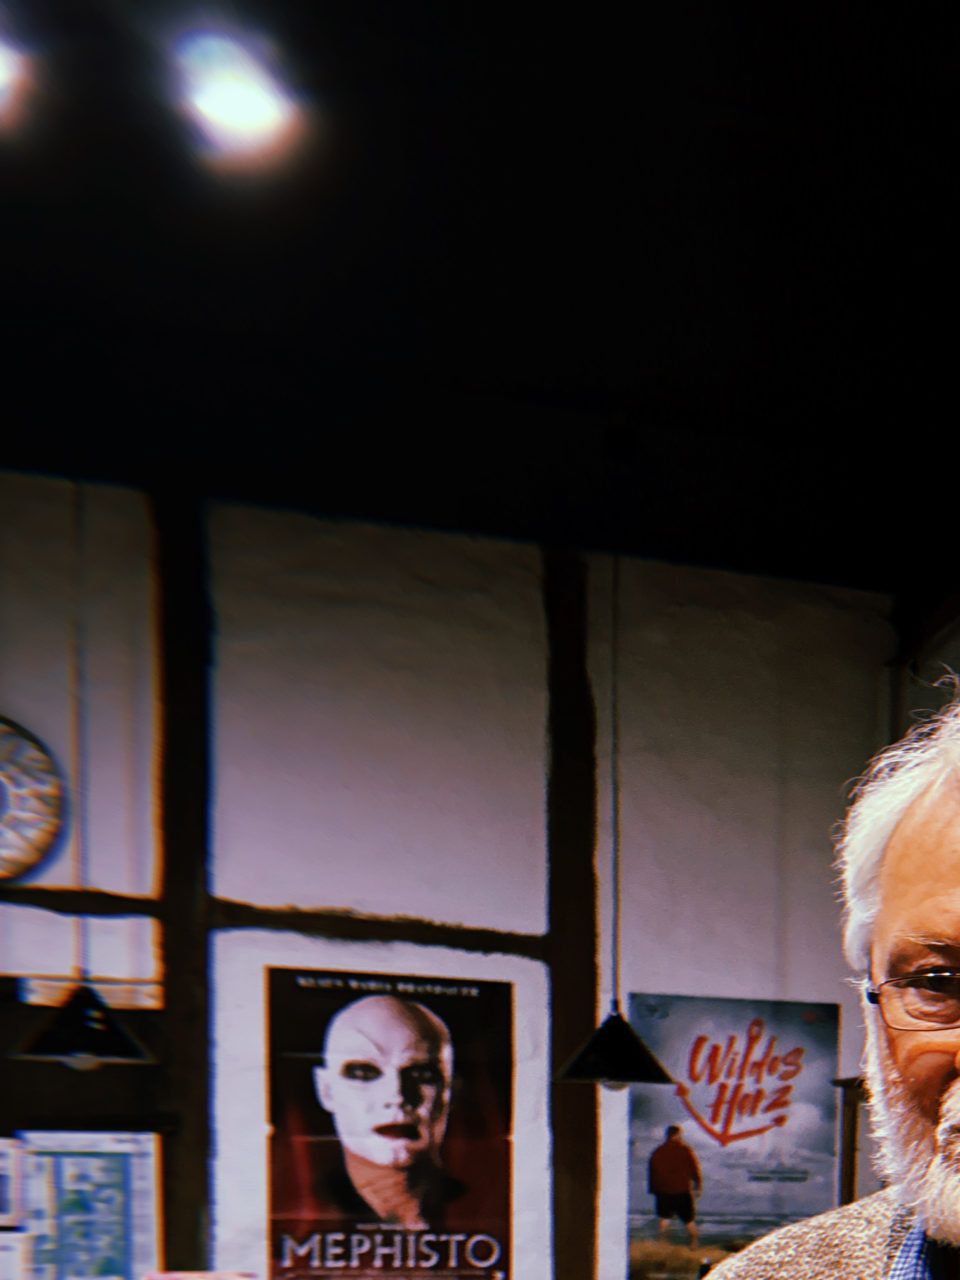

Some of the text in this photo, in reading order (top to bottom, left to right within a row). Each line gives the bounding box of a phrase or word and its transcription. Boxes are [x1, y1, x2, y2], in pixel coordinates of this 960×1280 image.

[689, 1018, 806, 1085] Wildes
[707, 1082, 794, 1131] Herz
[279, 1232, 502, 1268] MEPHISTO
